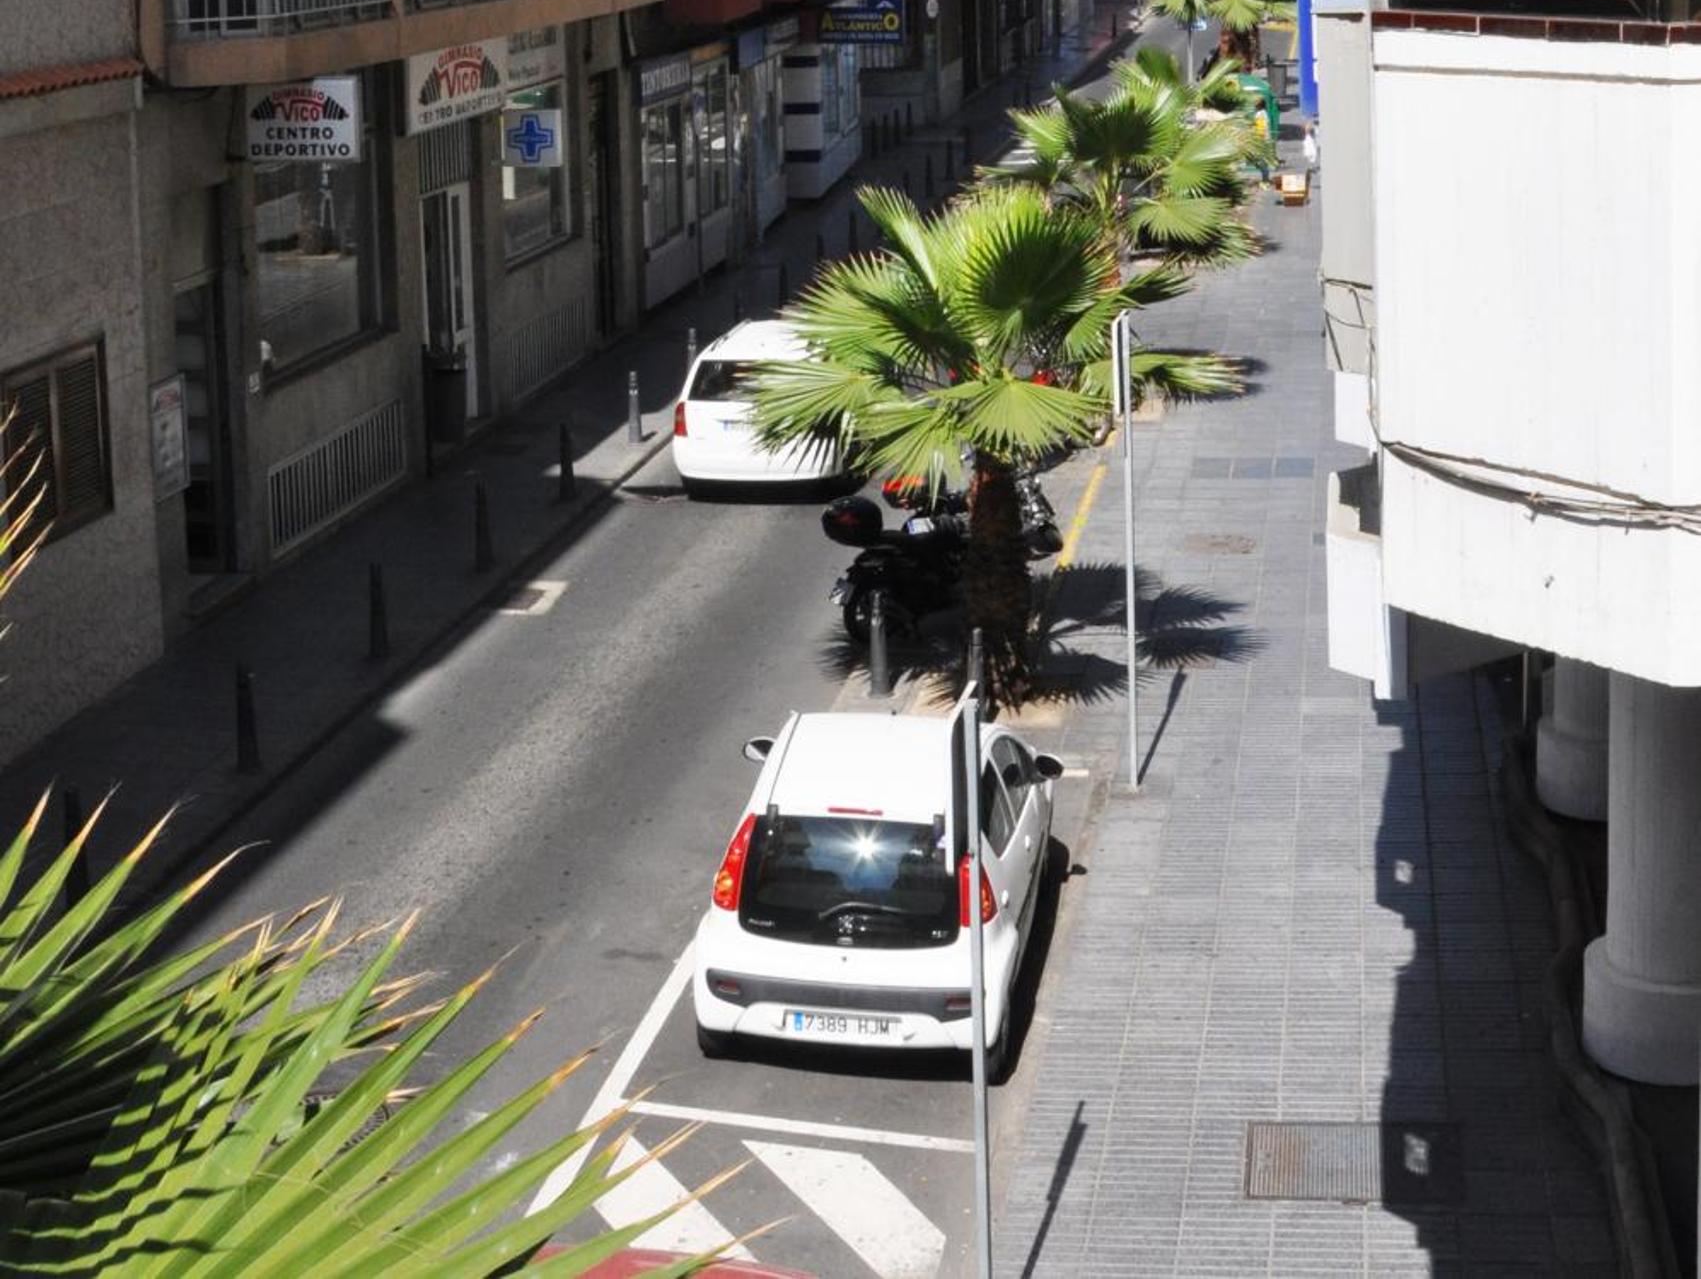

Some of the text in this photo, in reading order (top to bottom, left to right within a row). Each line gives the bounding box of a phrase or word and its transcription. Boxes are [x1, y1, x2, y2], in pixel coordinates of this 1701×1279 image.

[440, 60, 481, 99] VICO
[276, 99, 324, 122] VICO
[265, 126, 335, 141] CENTRO
[250, 143, 351, 157] DEPORTIVO
[805, 1013, 848, 1033] 7389
